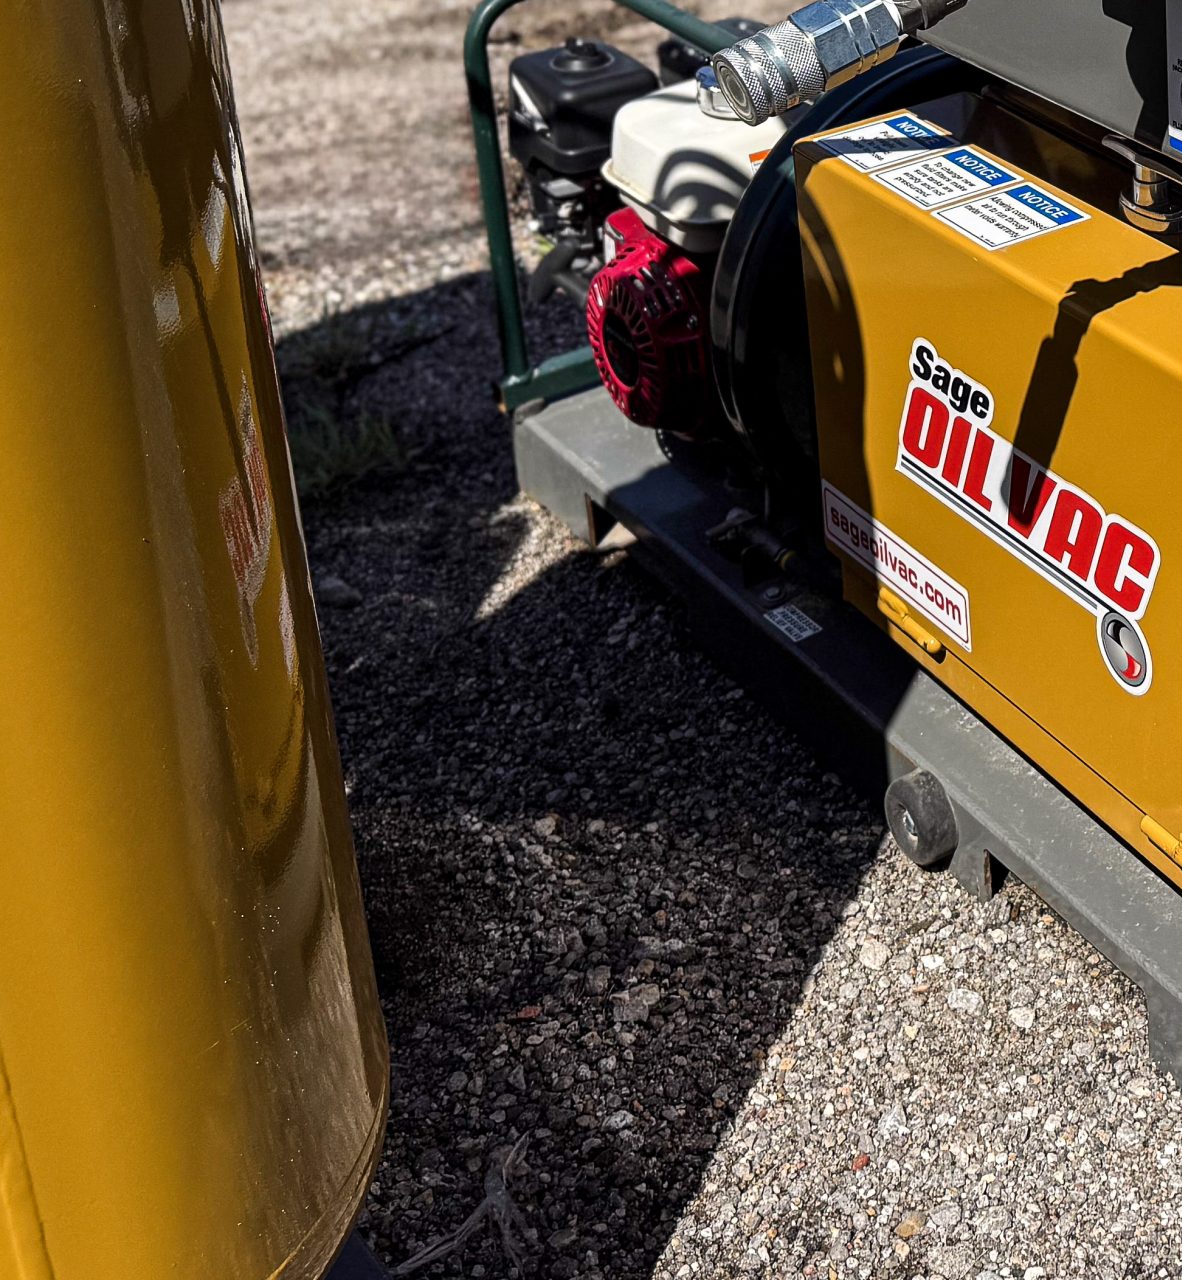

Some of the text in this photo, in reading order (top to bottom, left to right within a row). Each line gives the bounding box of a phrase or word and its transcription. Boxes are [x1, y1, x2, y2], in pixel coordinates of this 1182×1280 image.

[955, 153, 1003, 181] NOTICE
[1018, 190, 1068, 219] NOTICE
[912, 345, 990, 420] Sage
[902, 386, 1156, 613] OIL VAC
[830, 505, 963, 626] sageoilvac.com
